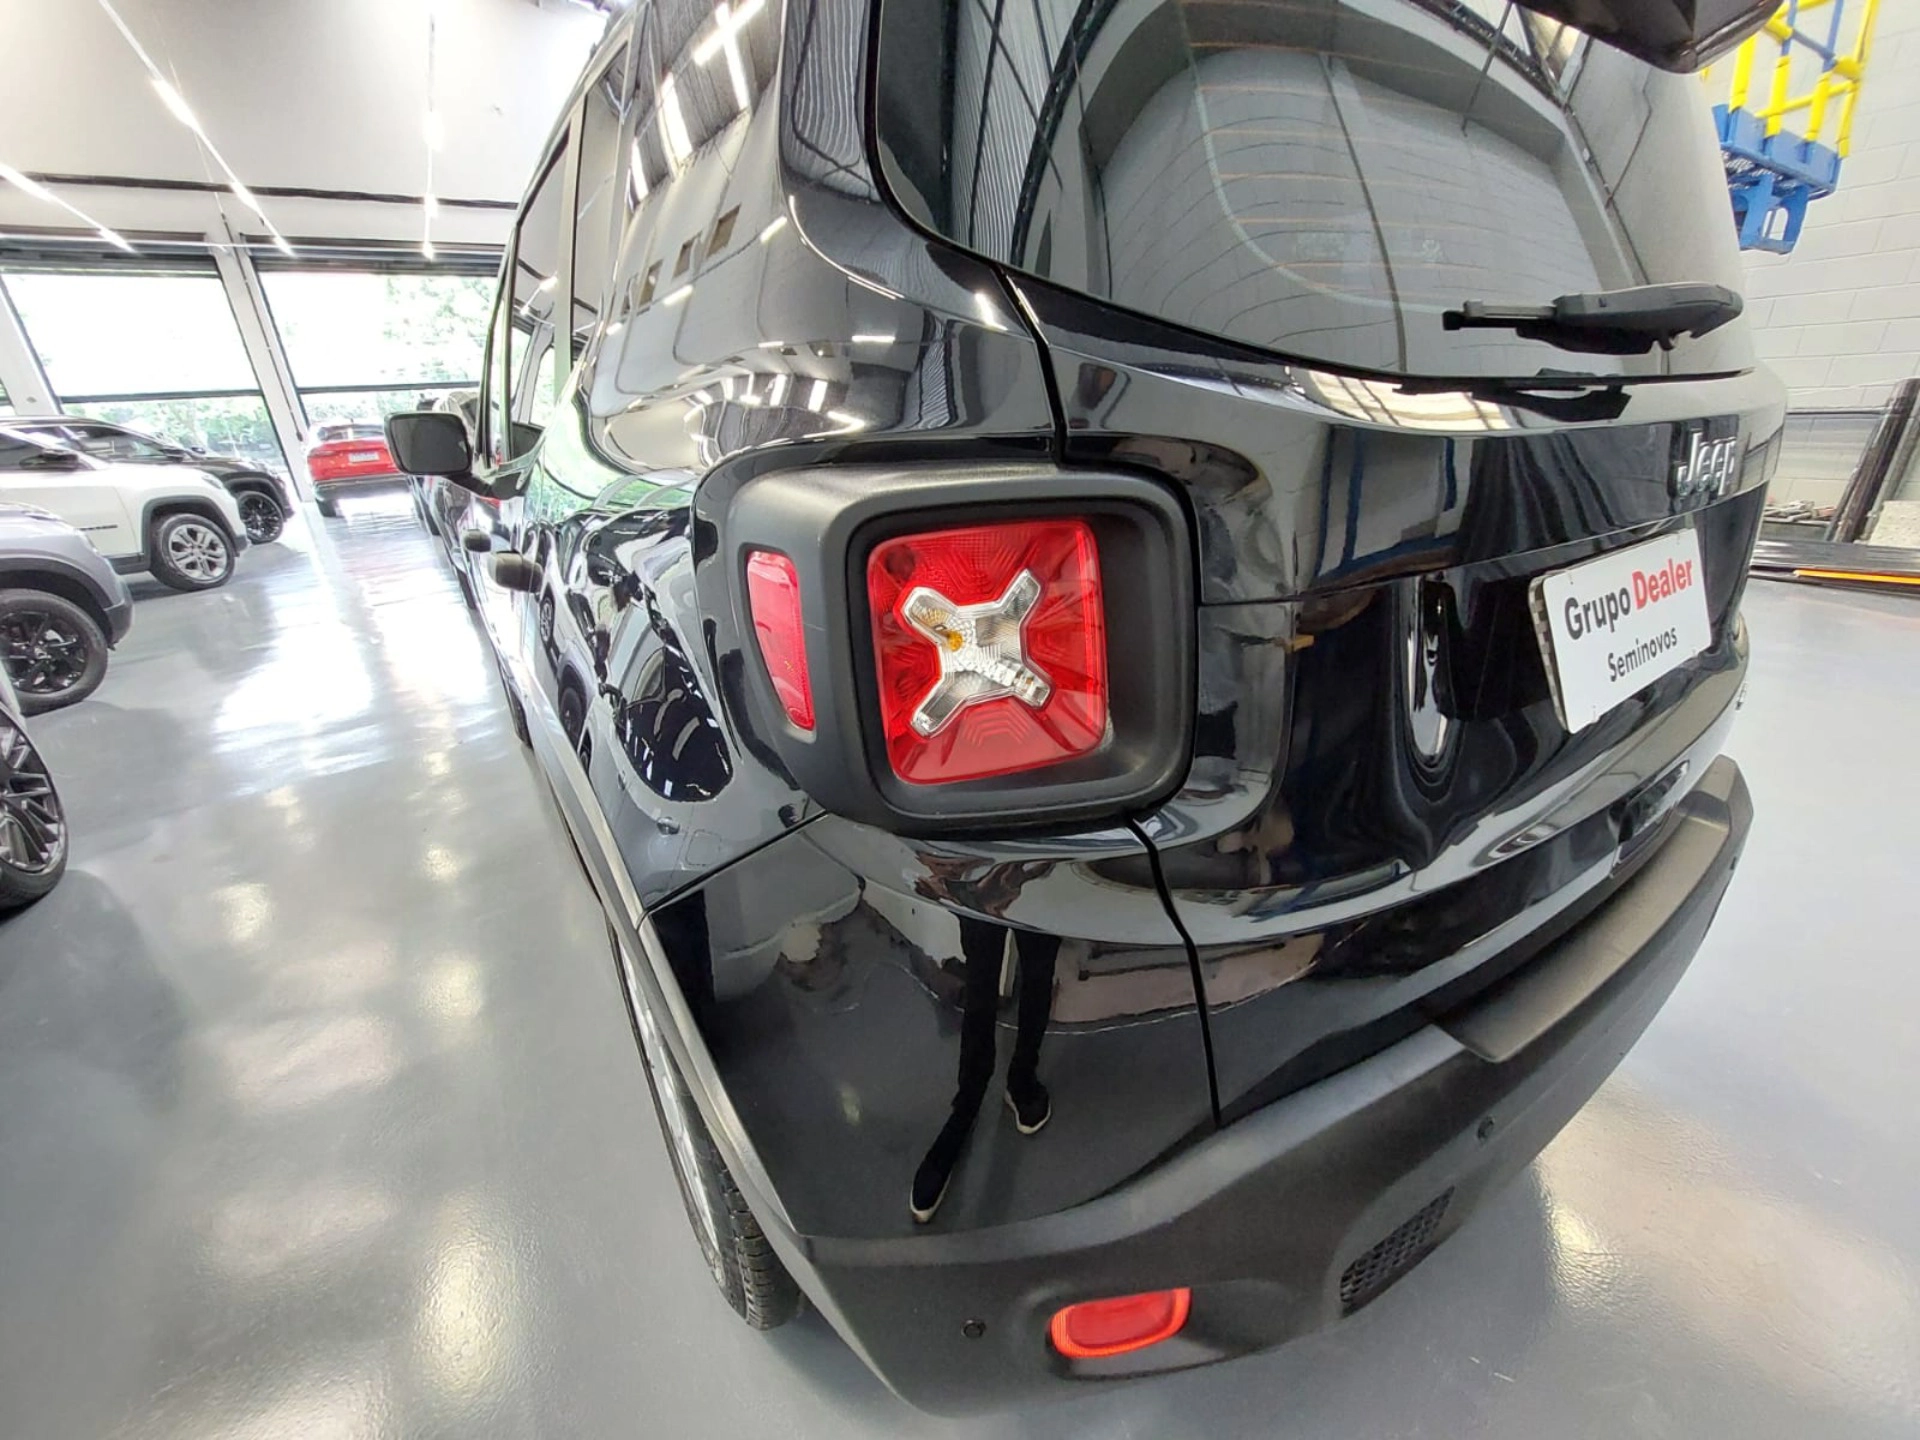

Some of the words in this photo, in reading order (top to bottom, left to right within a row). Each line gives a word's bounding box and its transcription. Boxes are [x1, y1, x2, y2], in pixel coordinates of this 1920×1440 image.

[1677, 429, 1737, 497] Jeep
[1565, 586, 1632, 640] Grupo
[1632, 558, 1693, 610] Dealer
[1607, 627, 1678, 682] Seminovos
